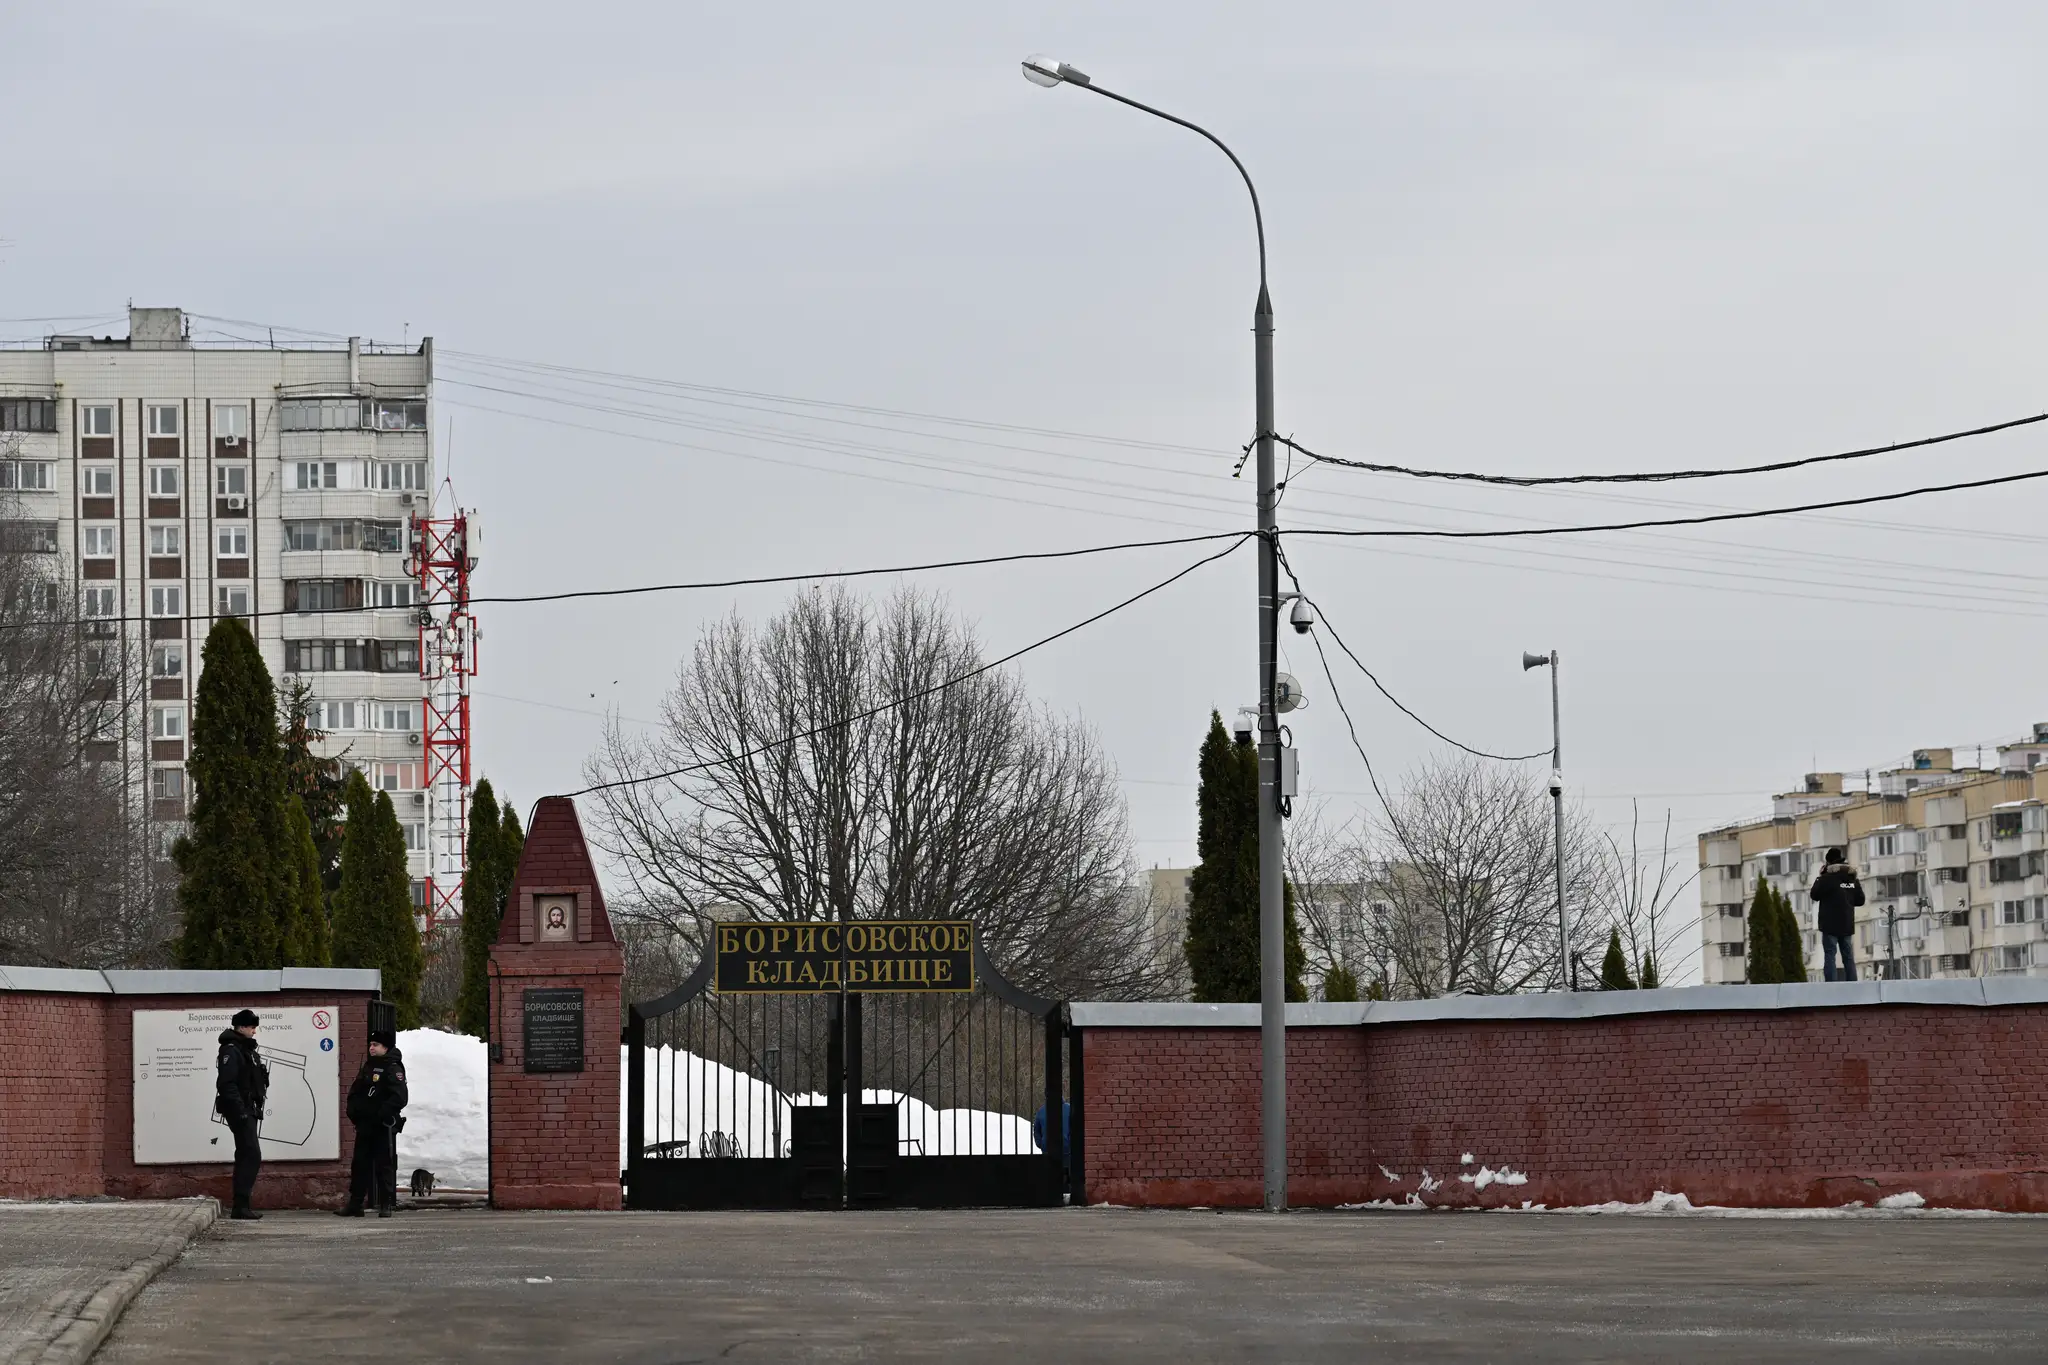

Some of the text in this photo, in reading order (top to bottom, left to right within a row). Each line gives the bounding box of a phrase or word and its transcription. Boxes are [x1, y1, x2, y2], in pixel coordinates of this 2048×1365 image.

[720, 926, 969, 953] БОРИСОВСКОЕ
[746, 959, 952, 988] КЛАДБИЩЕ
[525, 1002, 582, 1011] БОРИСОВСКОЕ
[188, 1013, 233, 1023] Борисовско
[532, 1014, 575, 1022] КЛАДБИЩЕ
